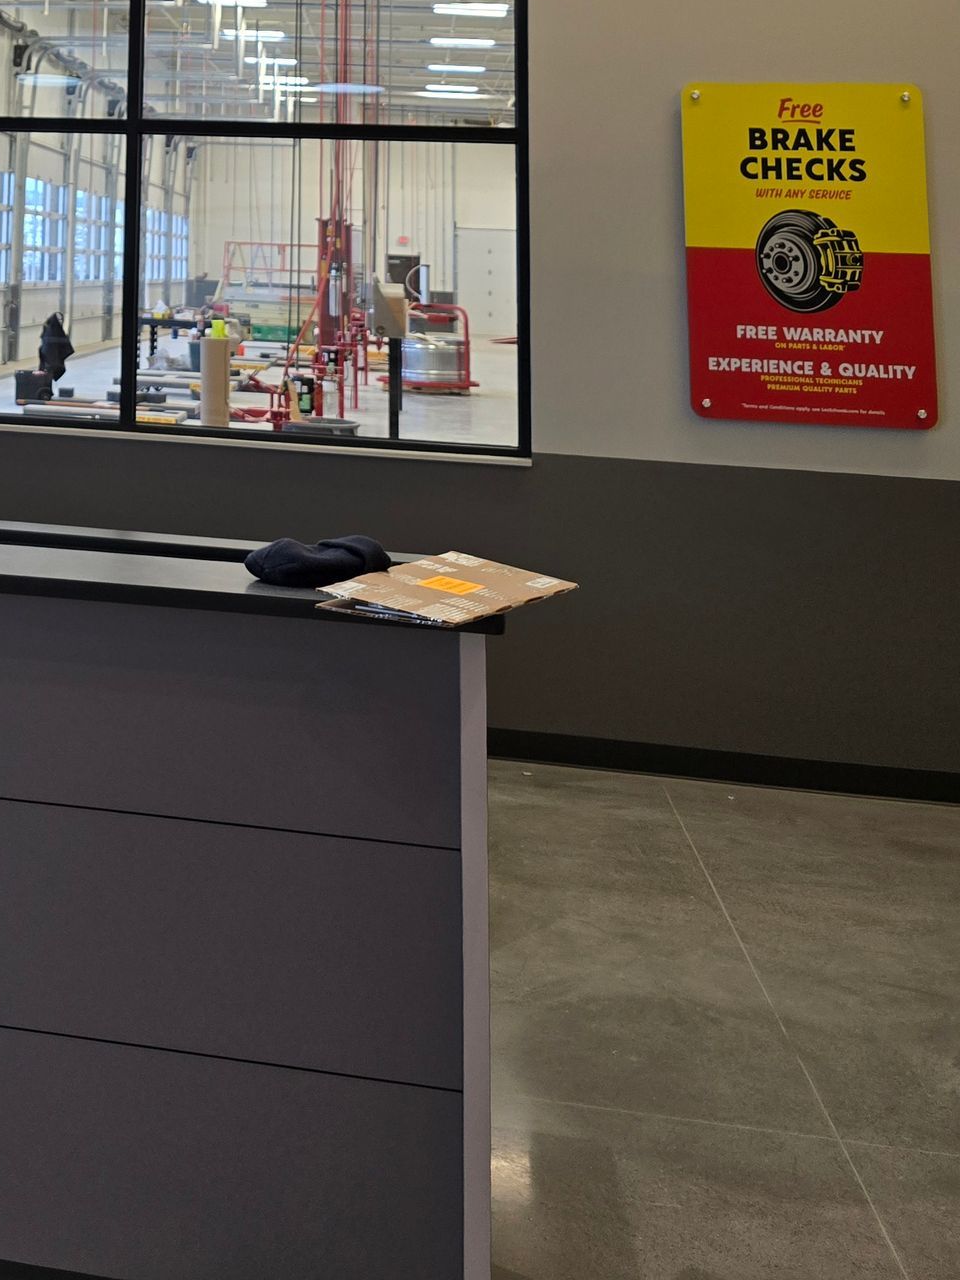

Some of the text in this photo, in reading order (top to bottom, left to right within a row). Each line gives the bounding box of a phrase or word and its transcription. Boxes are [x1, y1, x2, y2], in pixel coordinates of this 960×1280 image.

[777, 96, 825, 119] Free
[748, 127, 856, 152] BRAKE
[740, 156, 867, 182] CHECKS
[755, 188, 852, 200] WITH ANY SERVICE
[736, 325, 884, 345] FREE WARRANTY
[774, 342, 787, 350] ON
[788, 342, 810, 350] PARTS
[708, 356, 917, 380] EXPERIENCE & QUALITY
[760, 374, 863, 386] PROFESSIONAL TECHNICIANS
[767, 383, 858, 395] PREMIUM QUALITY PARTS
